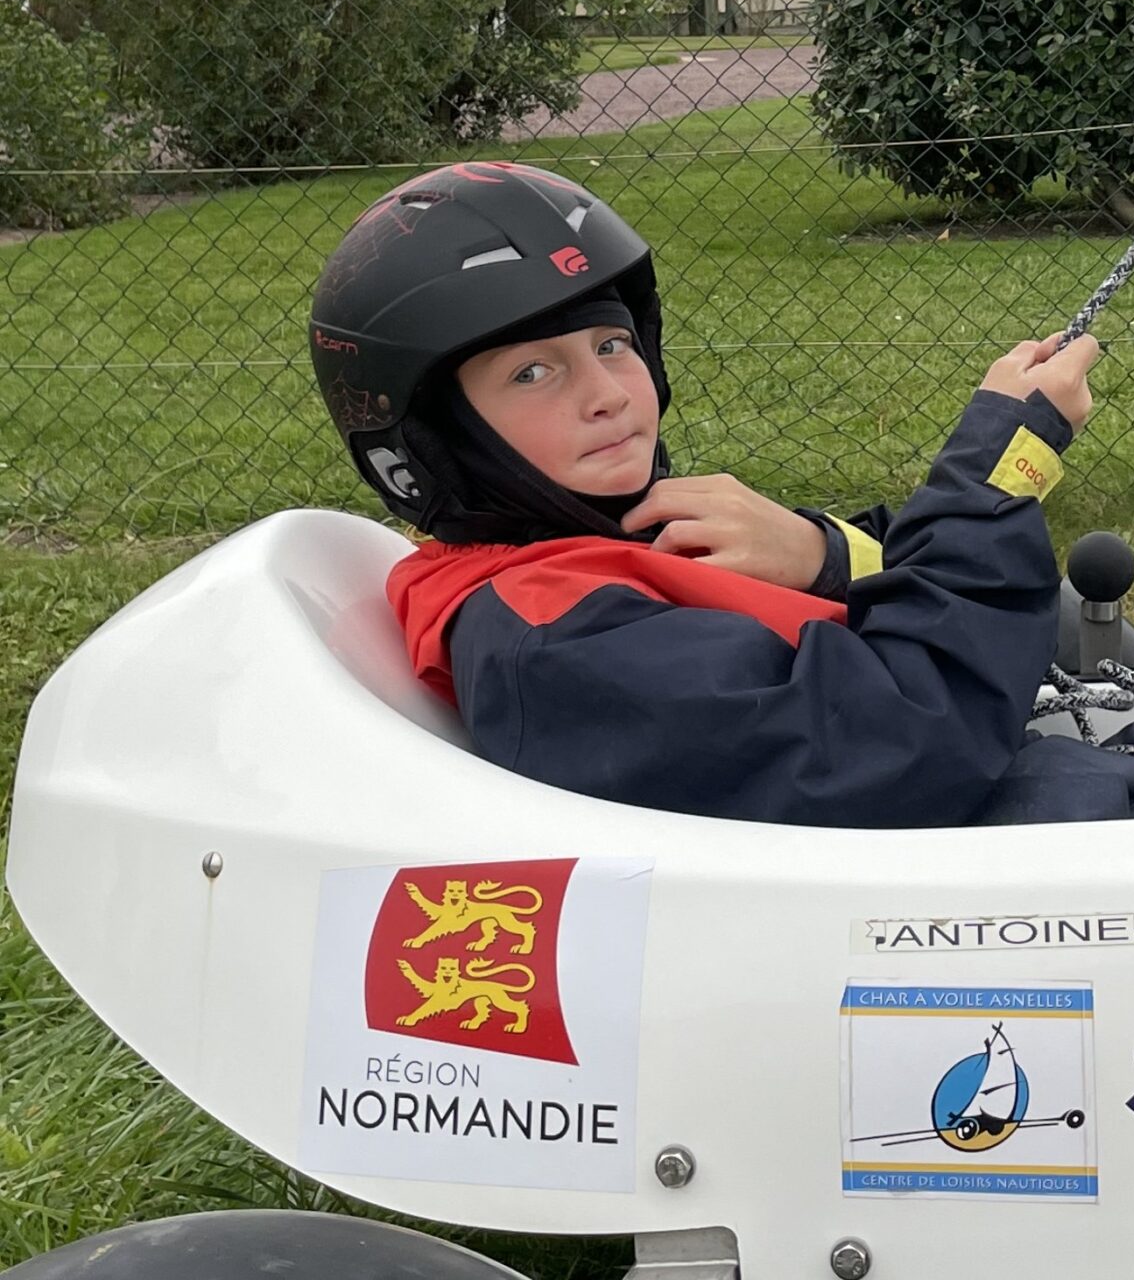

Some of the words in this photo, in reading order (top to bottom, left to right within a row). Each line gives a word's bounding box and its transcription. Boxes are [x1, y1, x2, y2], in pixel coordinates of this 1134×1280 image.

[890, 917, 1129, 948] ANTOINE
[859, 991, 908, 1006] CHAR
[914, 988, 927, 1006] À
[932, 991, 984, 1007] VOILE
[989, 993, 1073, 1008] ASNELLES
[366, 1053, 480, 1088] RÉGION
[318, 1085, 619, 1145] NORMANDIE
[861, 1174, 913, 1187] CENTRE
[918, 1175, 935, 1187] DE
[941, 1176, 992, 1188] LOISIRS
[996, 1178, 1080, 1191] NAUTIQUES
